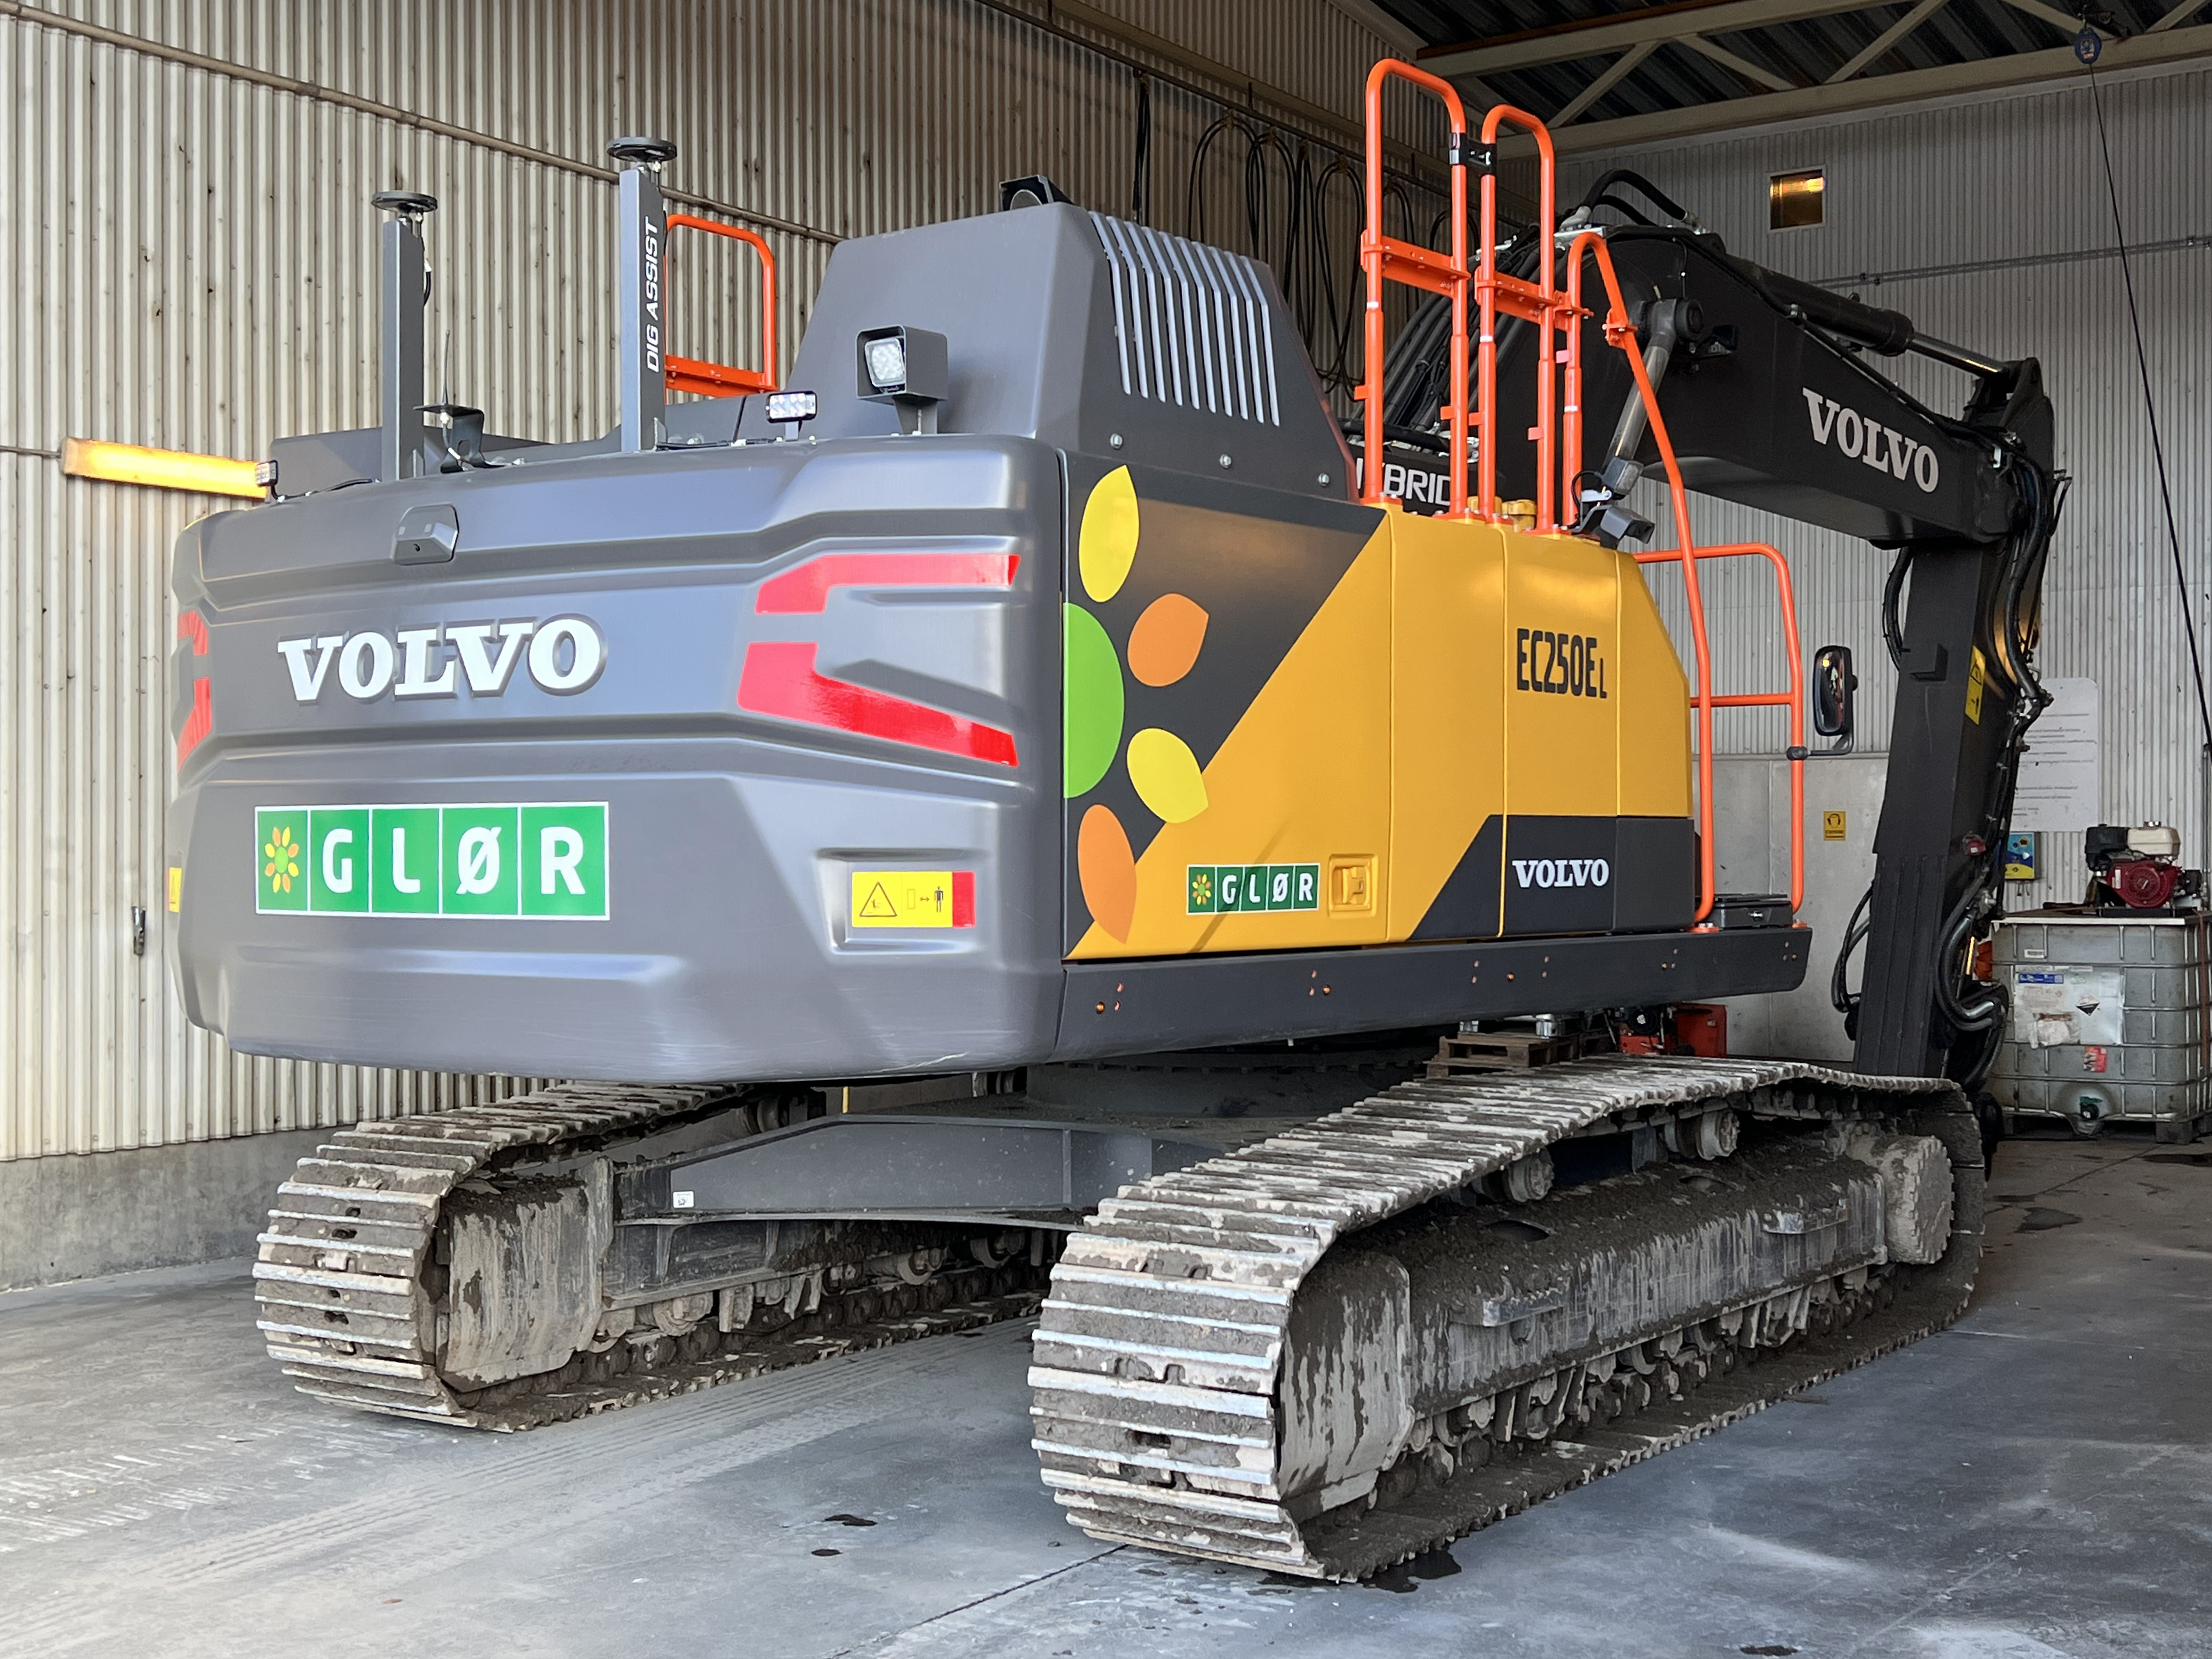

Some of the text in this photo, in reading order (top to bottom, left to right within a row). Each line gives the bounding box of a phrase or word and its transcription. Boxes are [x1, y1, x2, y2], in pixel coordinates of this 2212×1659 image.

[645, 216, 660, 373] DIG ASSIST
[1802, 387, 1939, 493] VOLVO
[1356, 458, 1450, 506] BRID
[277, 618, 602, 702] VOLVO
[321, 825, 586, 896] GLØR
[1222, 872, 1313, 905] GLØR
[1512, 859, 1610, 888] VOLVO
